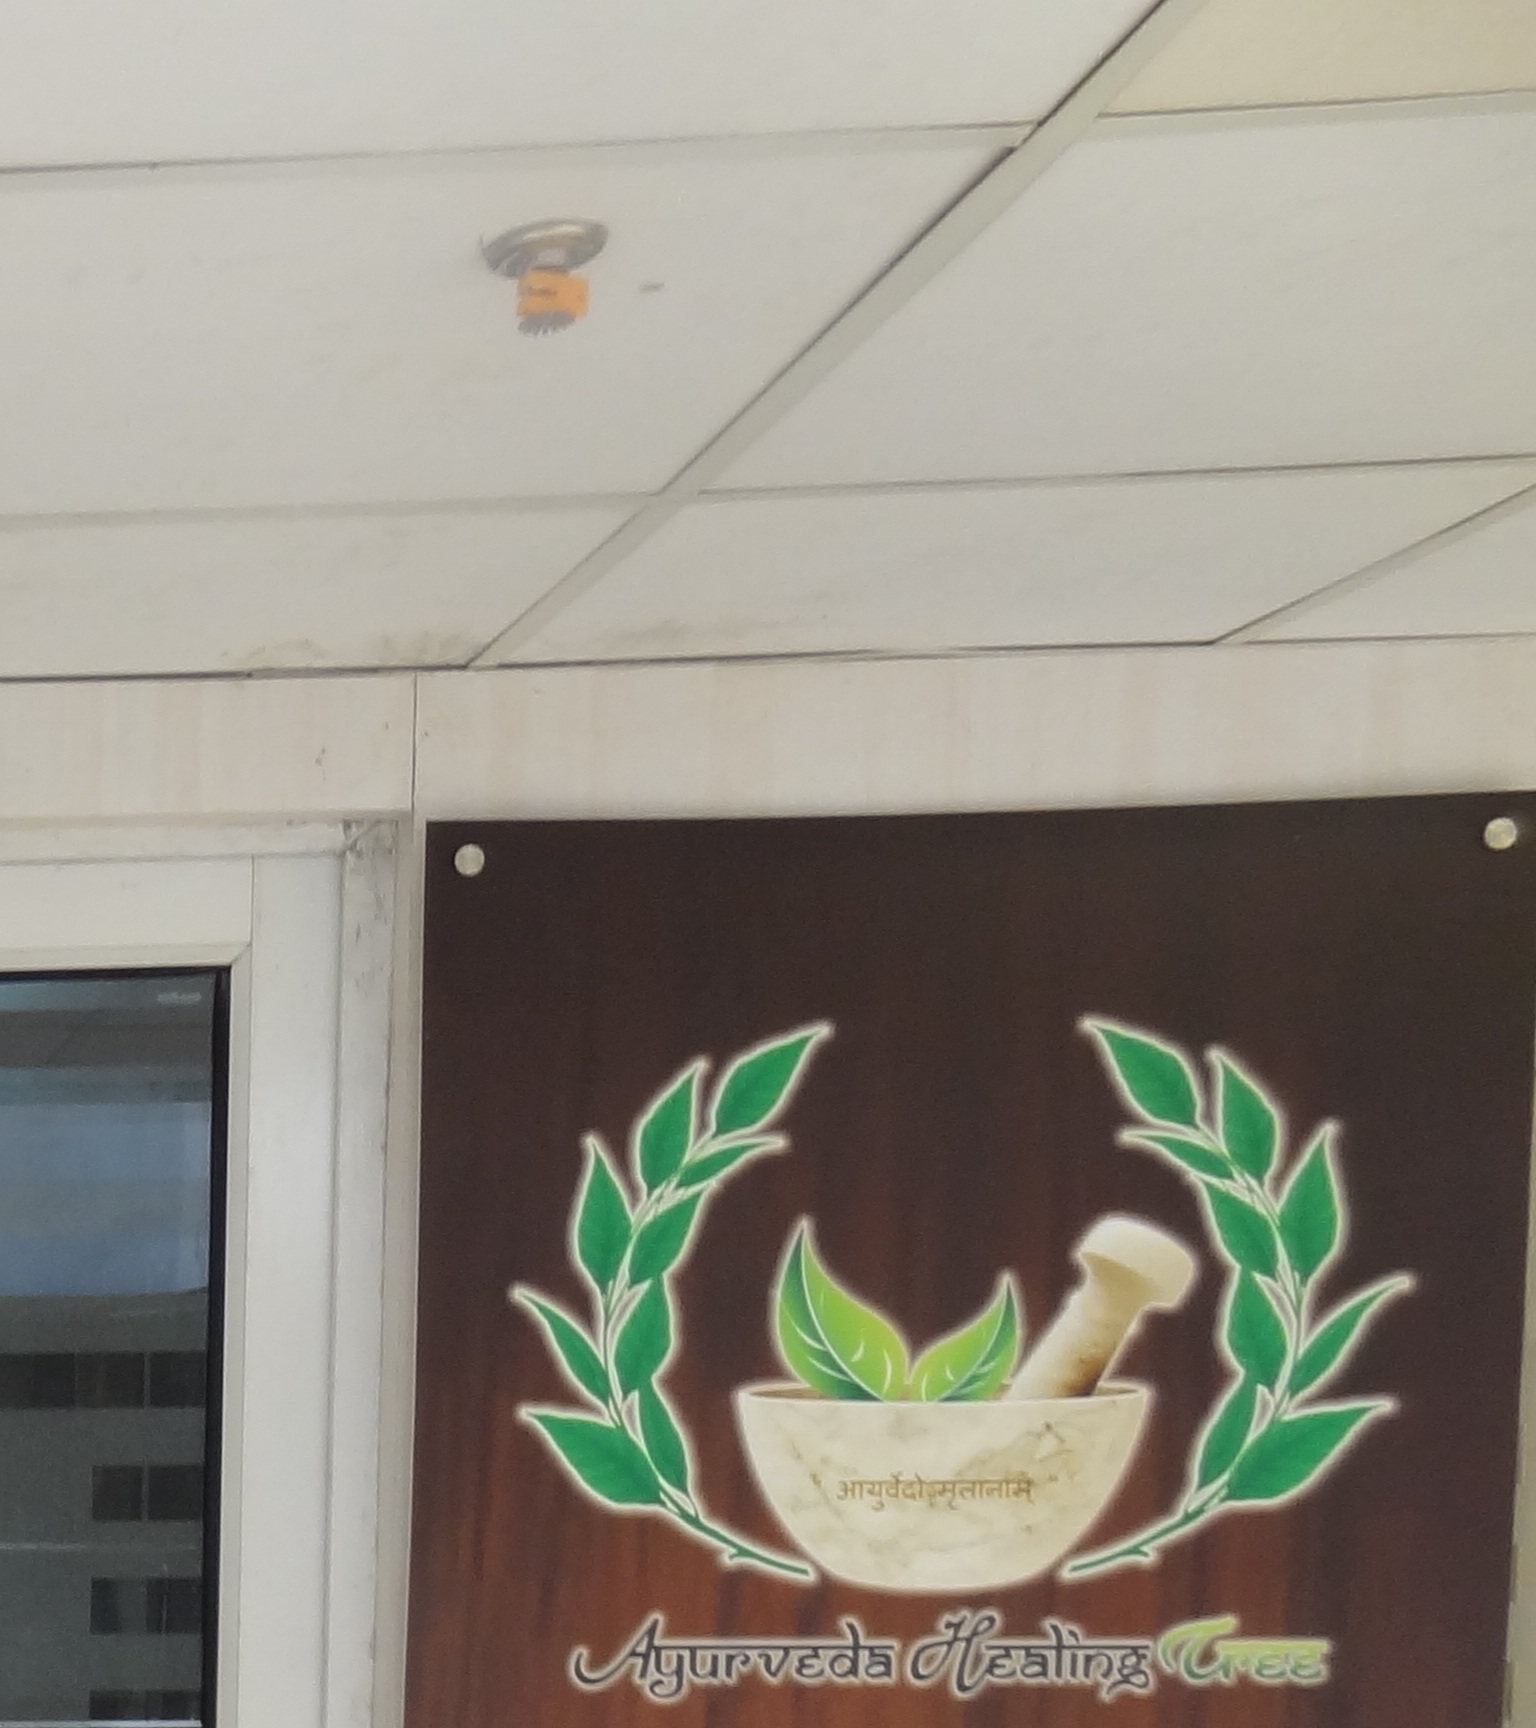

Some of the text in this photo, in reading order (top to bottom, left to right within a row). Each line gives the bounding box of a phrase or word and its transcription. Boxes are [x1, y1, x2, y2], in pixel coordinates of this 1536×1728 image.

[573, 1613, 1329, 1700] Ayurveda Healing Tree
